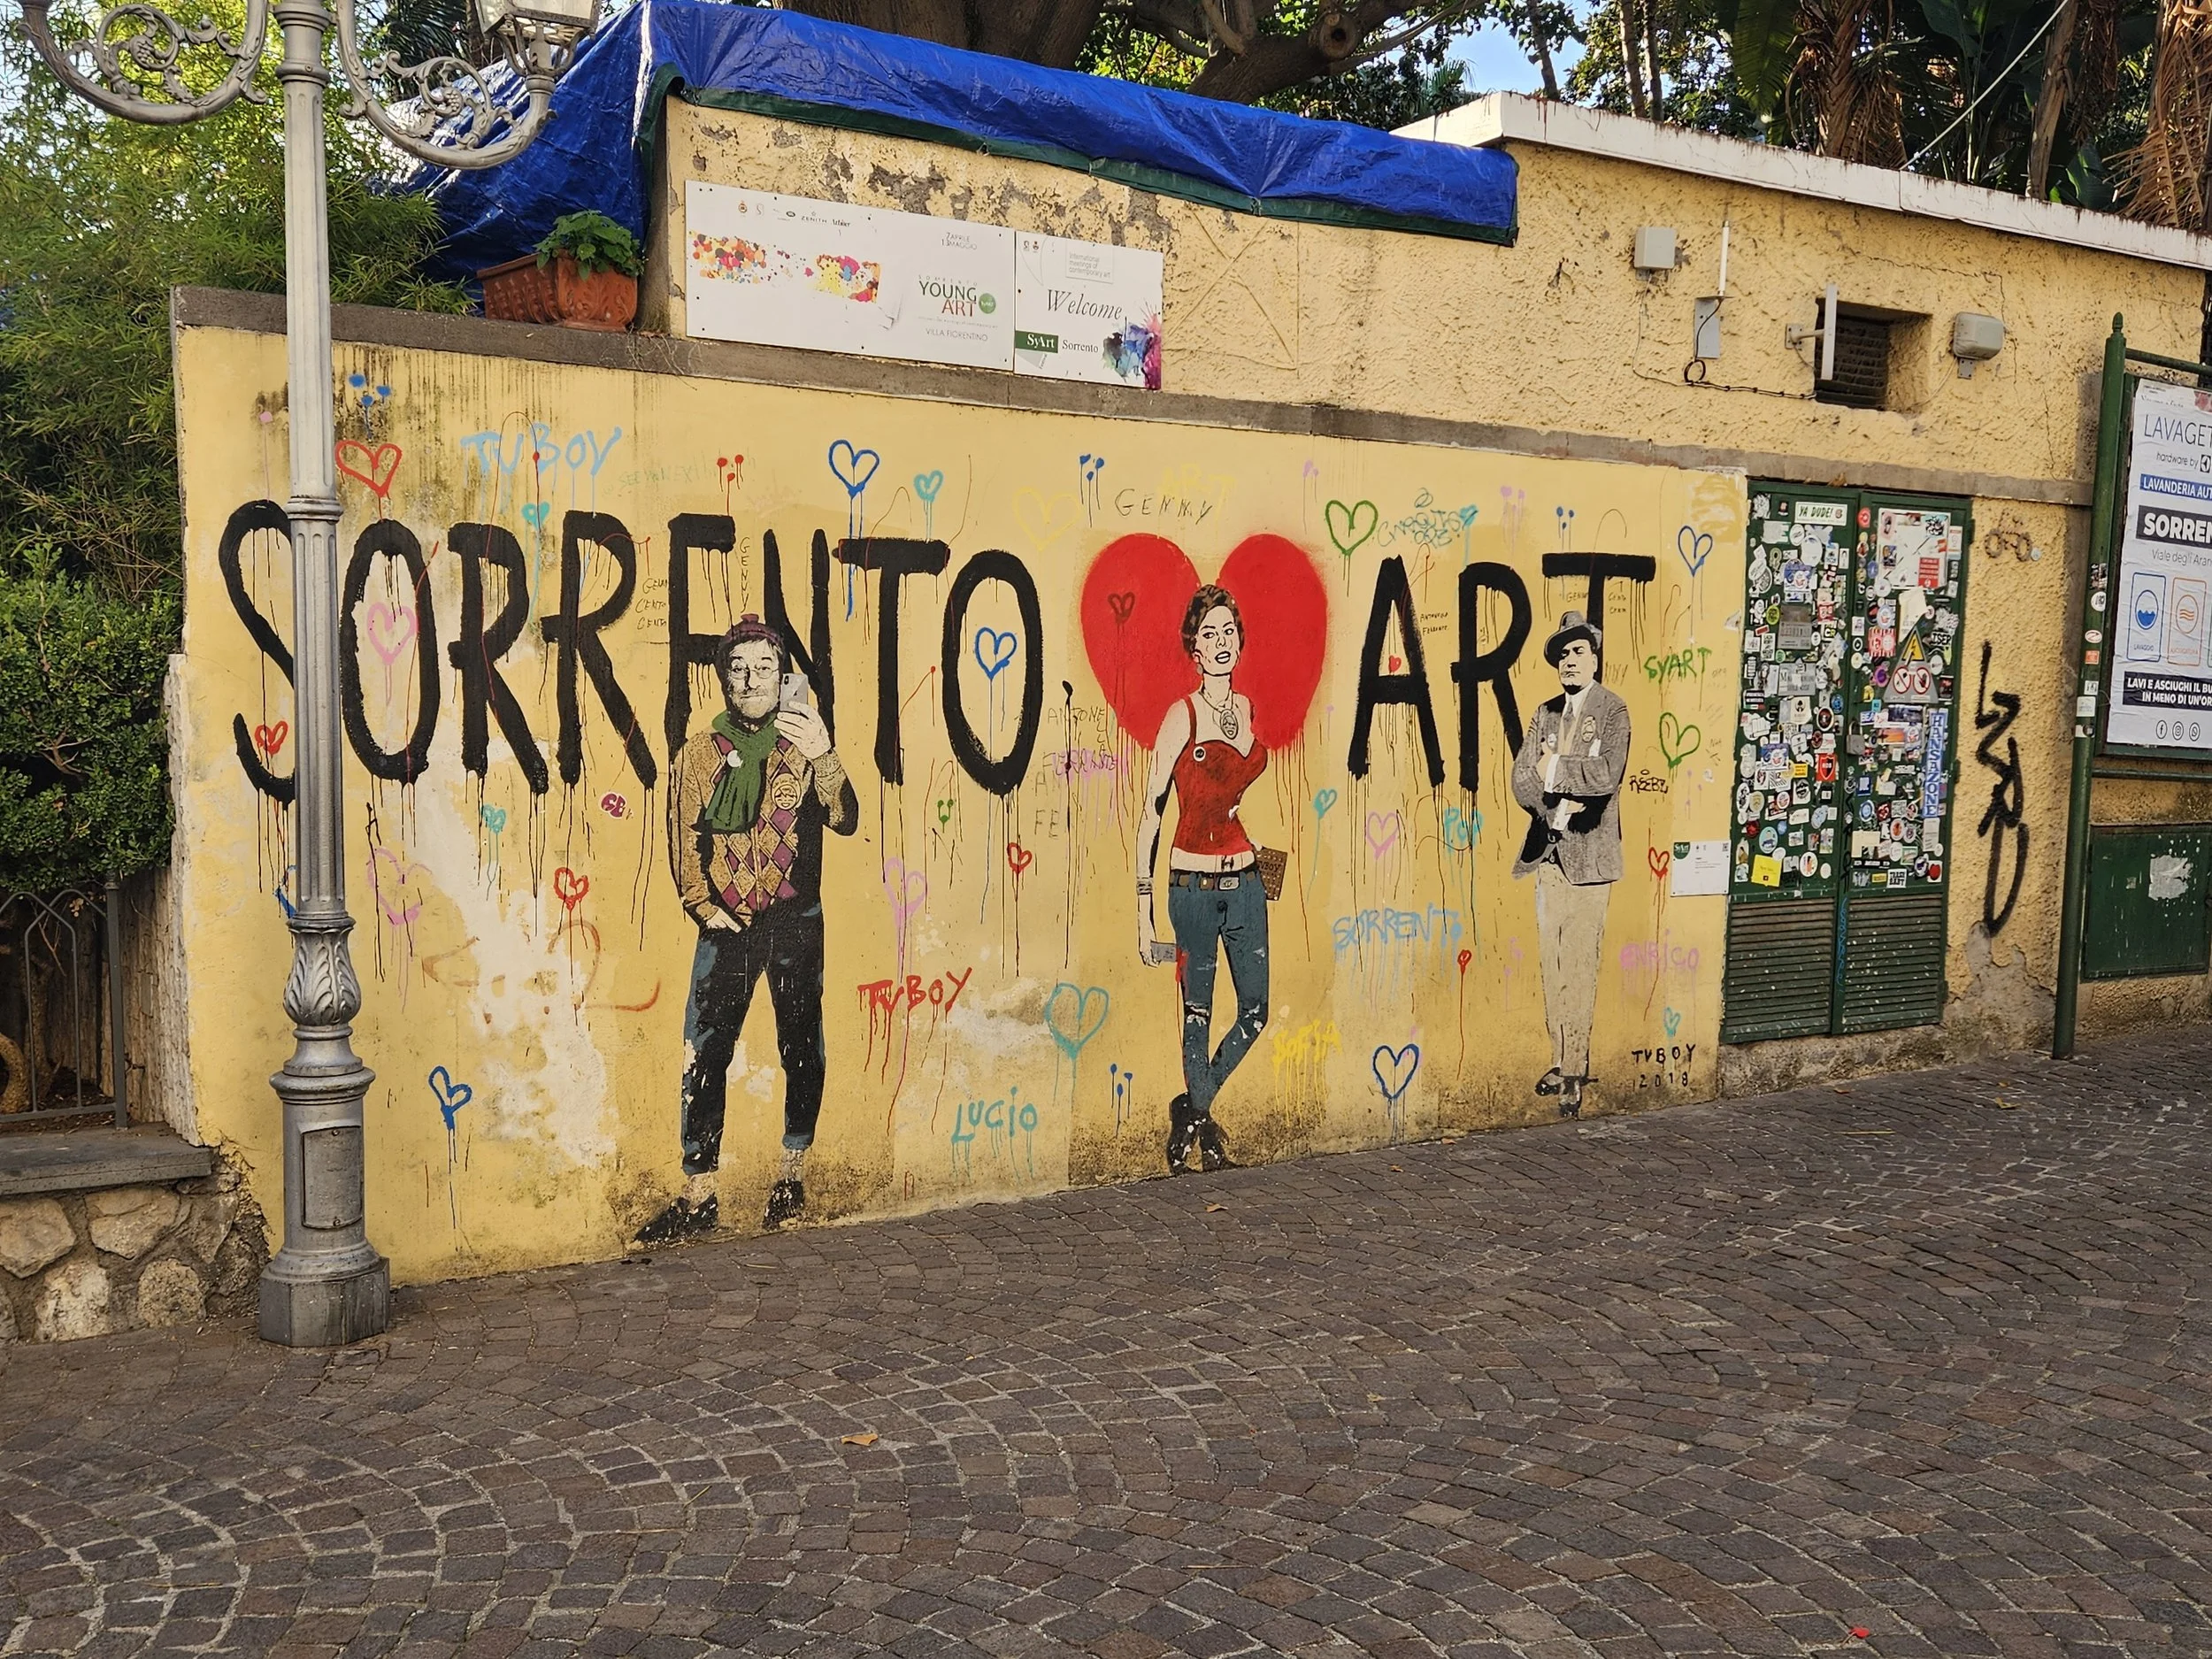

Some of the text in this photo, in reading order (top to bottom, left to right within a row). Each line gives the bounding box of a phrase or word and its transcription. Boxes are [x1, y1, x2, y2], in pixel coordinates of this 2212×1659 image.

[918, 280, 977, 303] YOUNG
[941, 299, 977, 317] ART
[1047, 288, 1123, 320] Welcome
[926, 327, 988, 342] VILLA FIORENTINO
[1026, 333, 1099, 353] SyArt Sorrento
[2156, 452, 2199, 470] hardware by
[2144, 476, 2196, 497] LAVANDERIA
[2152, 549, 2171, 562] Viale
[2172, 551, 2193, 566] degli
[219, 499, 1043, 803] SORRENTO
[1347, 553, 1656, 793] ART
[2127, 677, 2147, 689] LAVI
[2147, 679, 2154, 689] E
[2154, 680, 2193, 693] ASCIUGHI
[2193, 682, 2201, 693] IL
[2142, 691, 2152, 703] IN
[2152, 692, 2177, 704] MENO
[2177, 694, 2187, 705] DI
[1631, 1043, 1697, 1065] TVBOY
[1632, 1072, 1691, 1088] 2018
